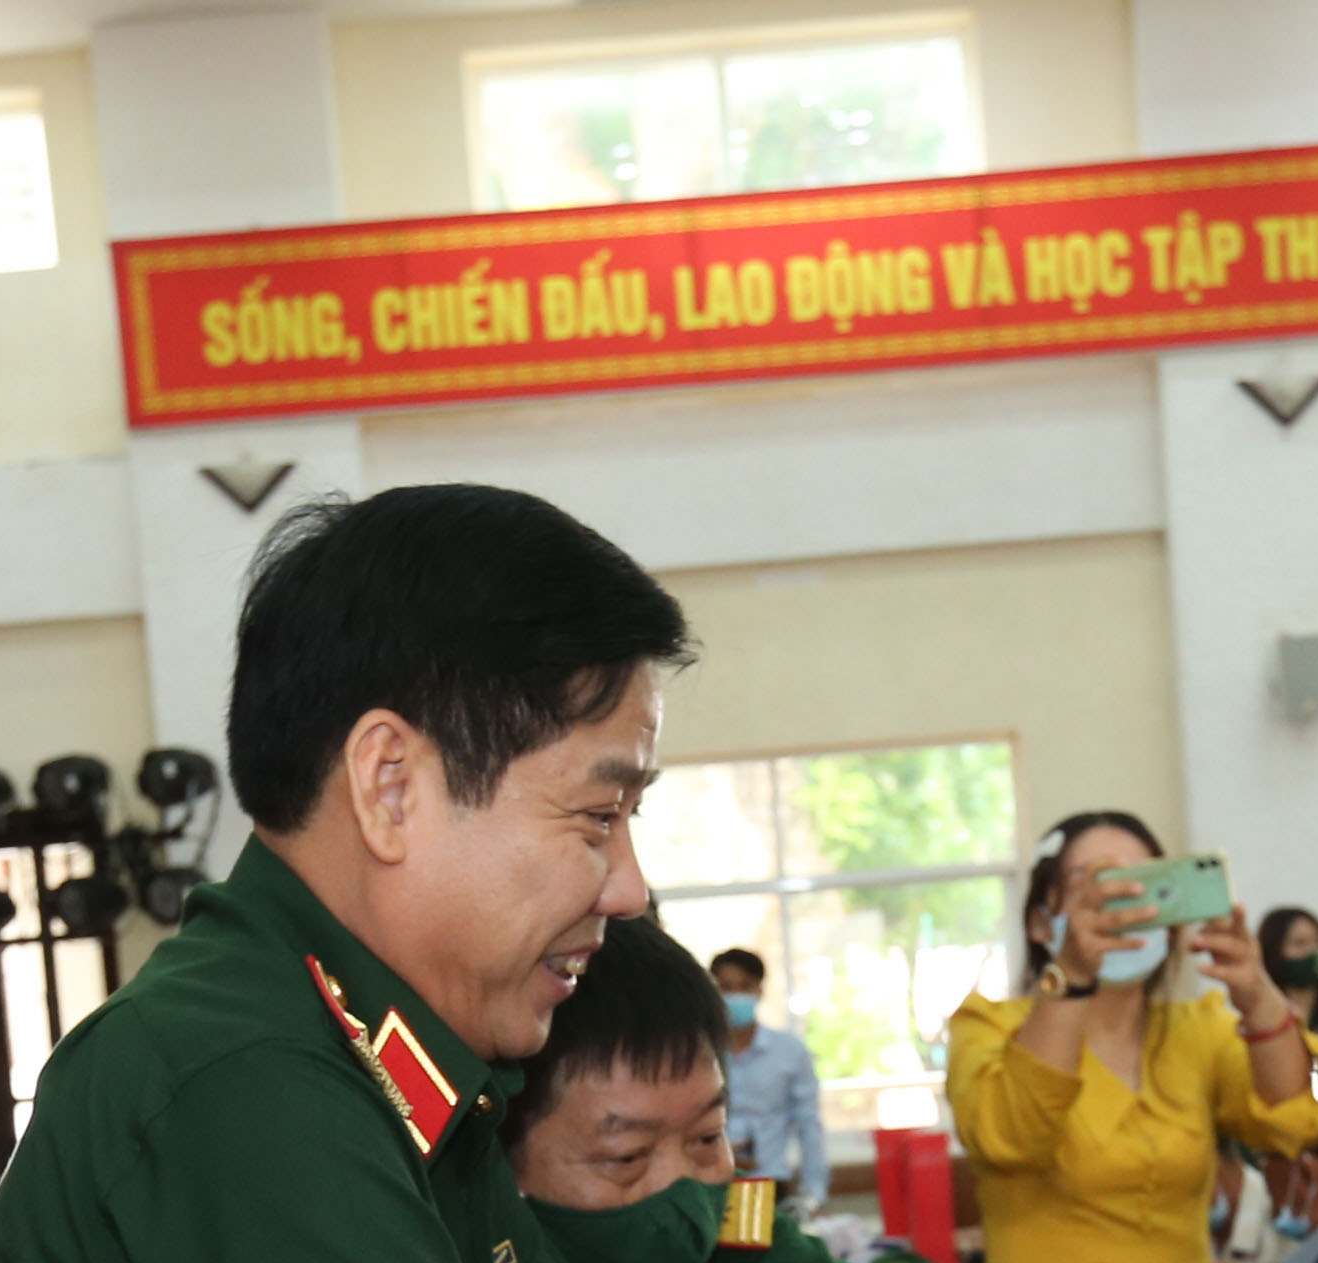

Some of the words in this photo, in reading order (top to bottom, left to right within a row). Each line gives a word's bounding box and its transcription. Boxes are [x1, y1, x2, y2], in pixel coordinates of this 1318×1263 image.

[199, 275, 362, 367] SỐNG,
[371, 258, 530, 353] CHIẾN
[540, 250, 666, 342] ĐẤU,
[673, 257, 776, 331] LAO
[784, 239, 932, 335] ĐỘNG
[940, 226, 1016, 309] VÀ
[1023, 228, 1133, 316] HỌC
[1141, 210, 1244, 306] TẬP
